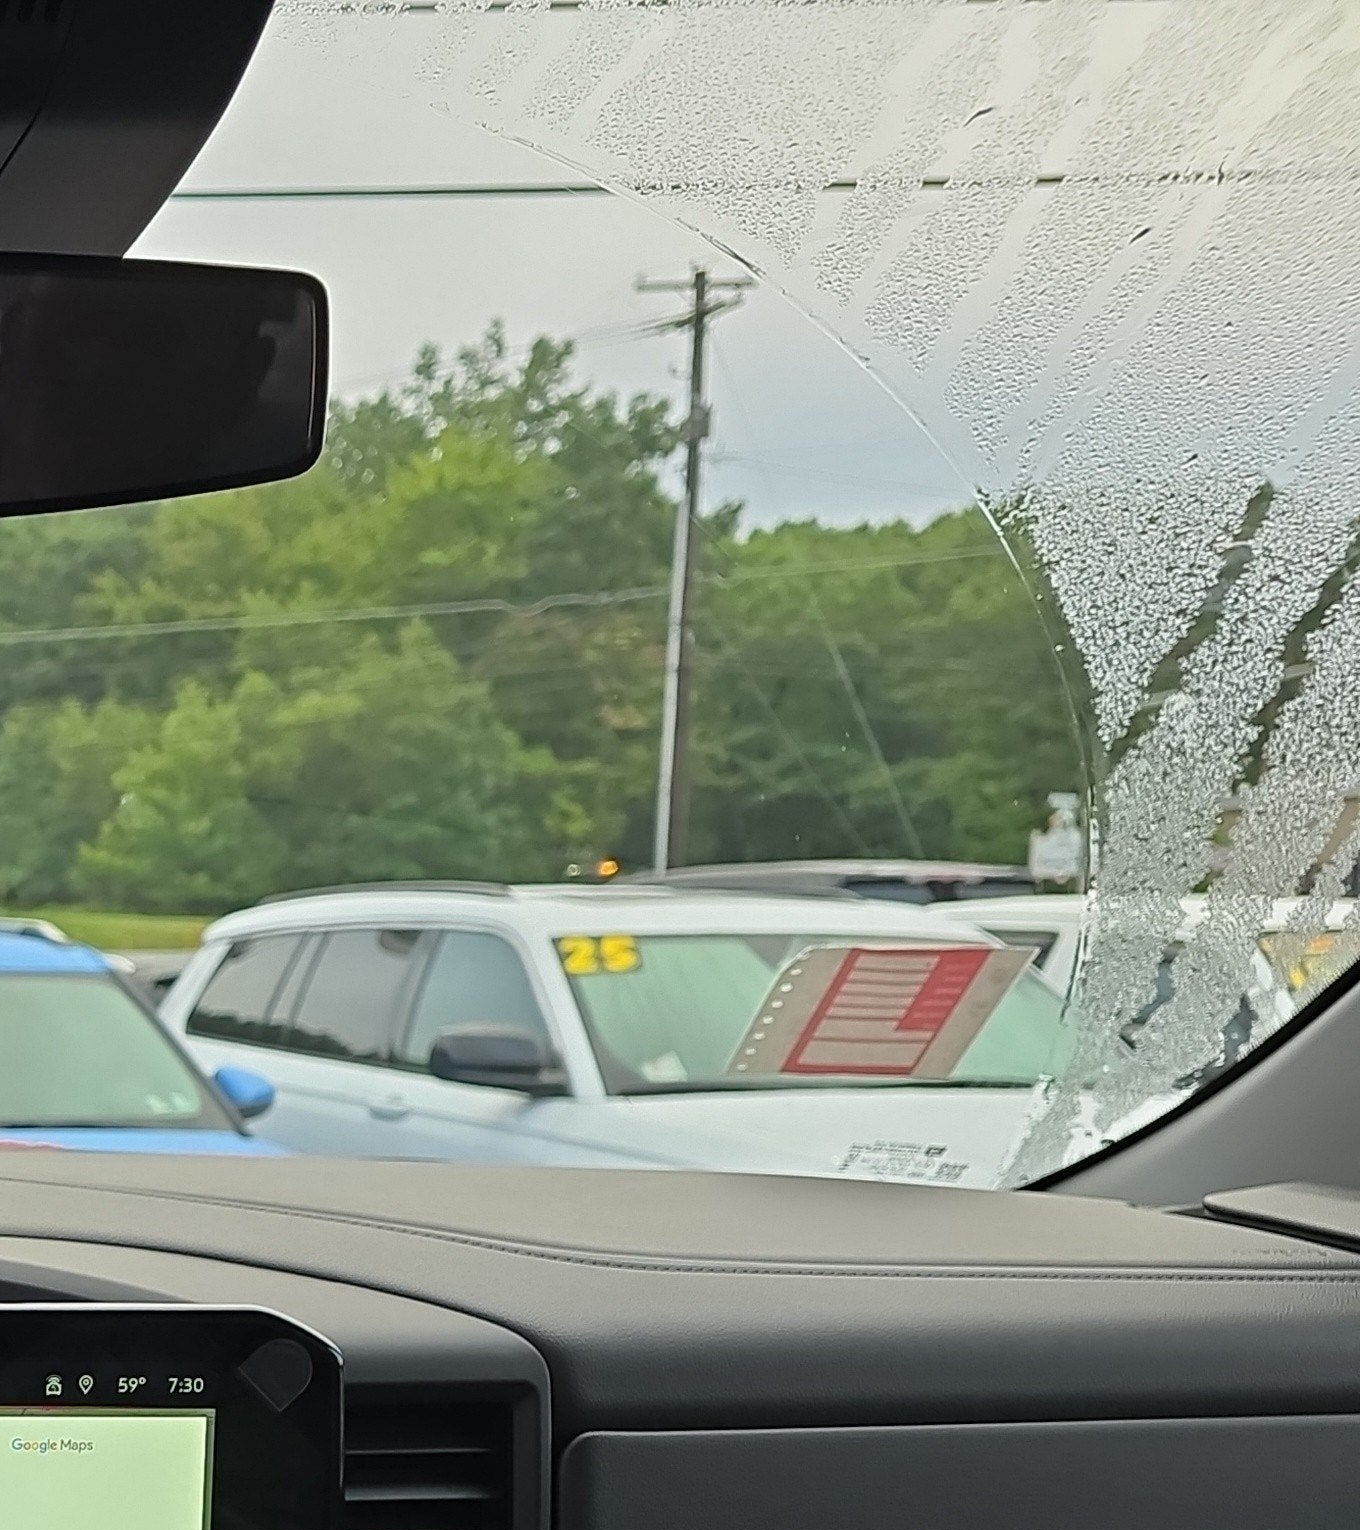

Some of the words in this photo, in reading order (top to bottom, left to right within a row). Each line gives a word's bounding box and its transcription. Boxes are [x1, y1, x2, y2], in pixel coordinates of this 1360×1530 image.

[559, 932, 640, 975] 25
[117, 1376, 147, 1394] 59°
[168, 1377, 204, 1394] 7:30
[11, 1437, 58, 1453] Google
[60, 1438, 94, 1452] Maps
